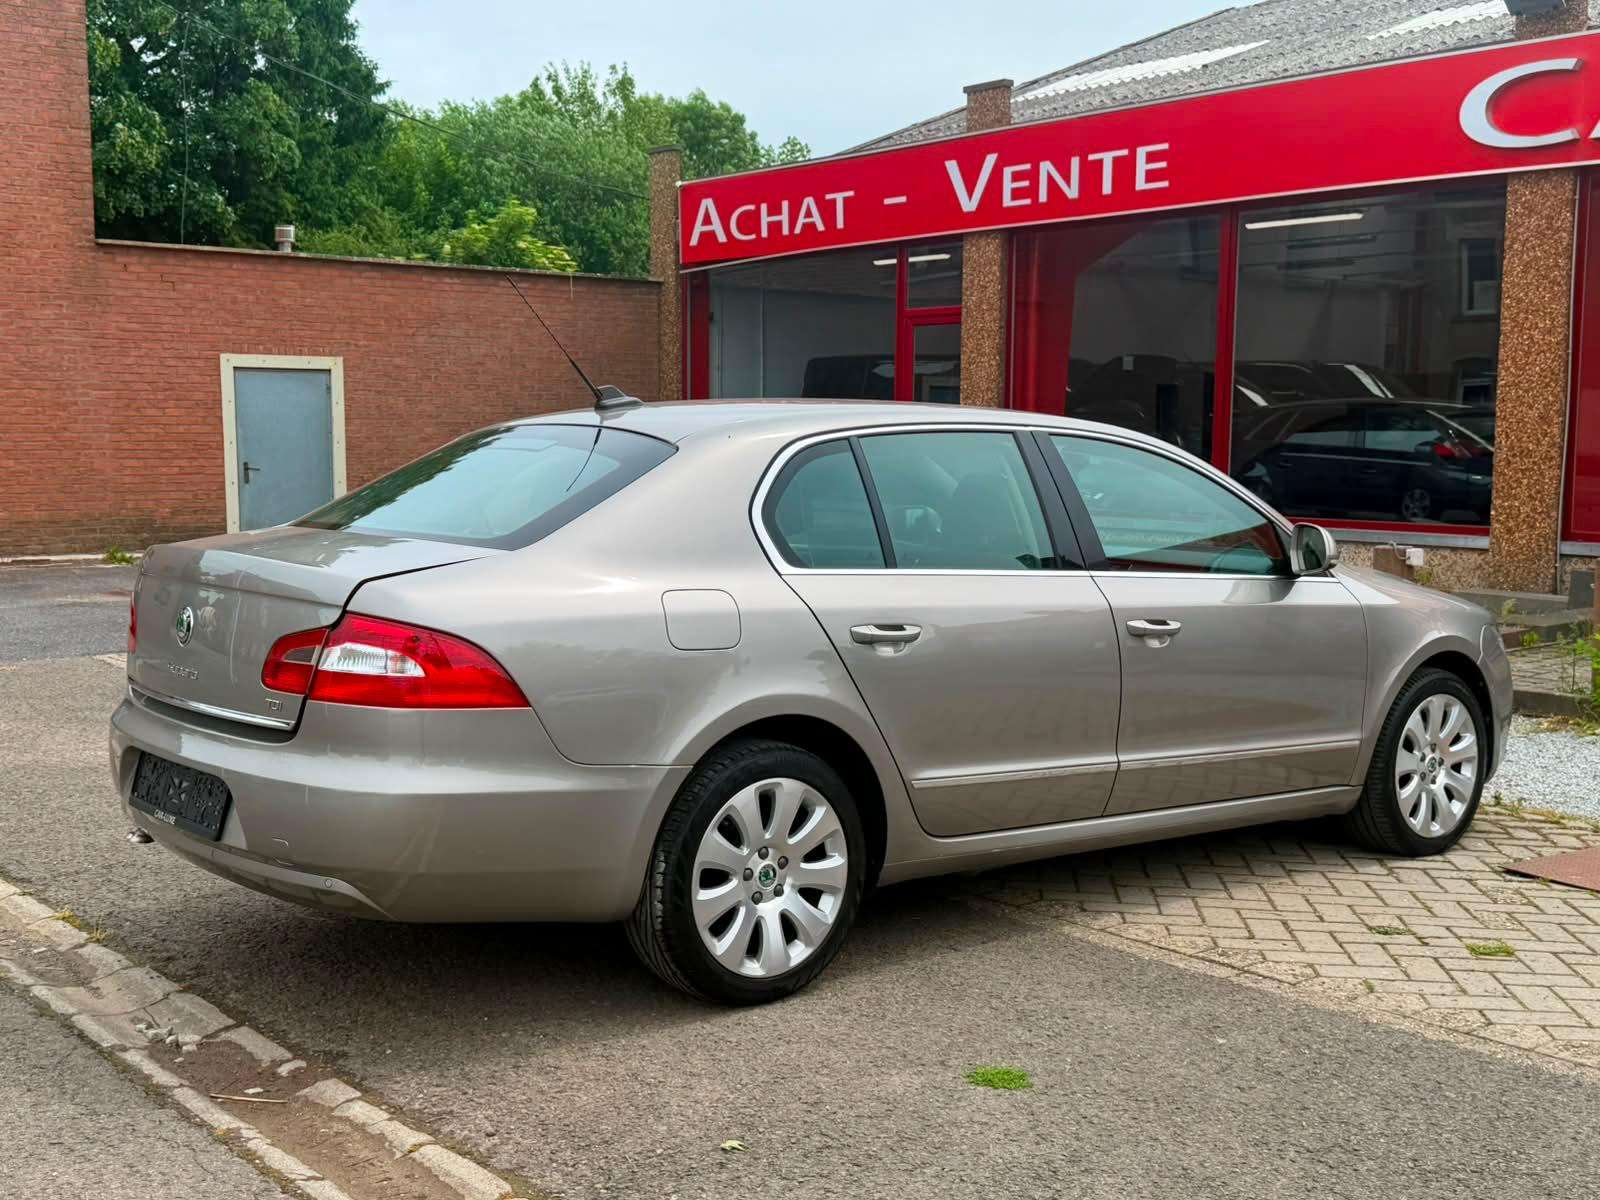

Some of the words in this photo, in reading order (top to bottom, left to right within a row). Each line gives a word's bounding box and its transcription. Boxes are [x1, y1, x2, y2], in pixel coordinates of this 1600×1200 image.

[1459, 58, 1600, 148] C
[689, 190, 855, 246] ACHAT
[945, 142, 1170, 212] VENTE
